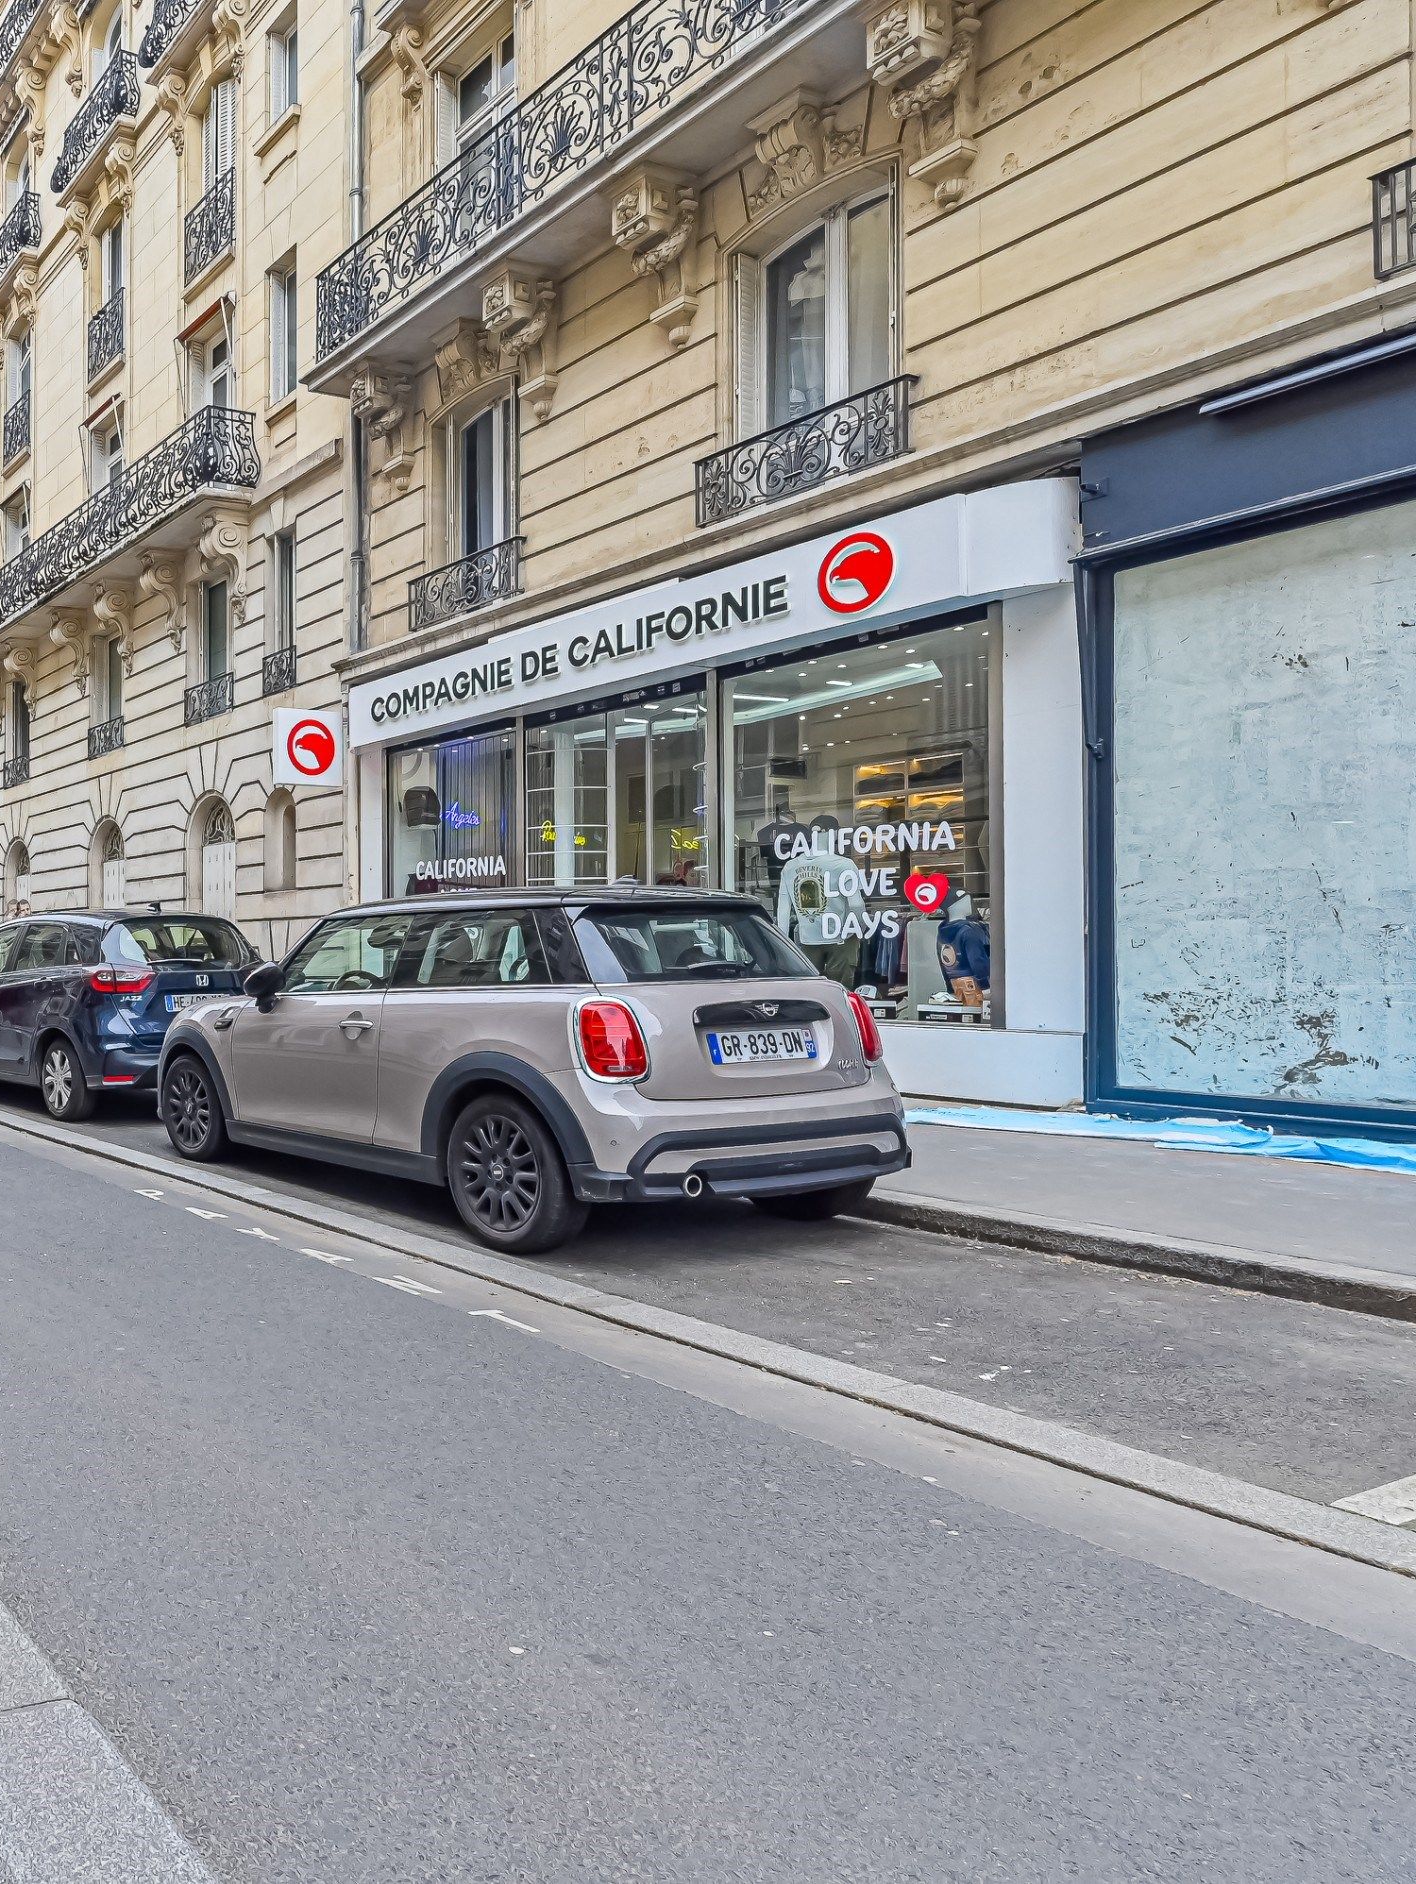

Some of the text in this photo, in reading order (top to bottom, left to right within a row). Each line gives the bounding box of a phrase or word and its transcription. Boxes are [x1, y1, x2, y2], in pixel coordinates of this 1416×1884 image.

[371, 574, 789, 723] COMPAGNIE DE CALIFORNIE
[774, 820, 956, 860] CALIFORNIA
[416, 855, 506, 880] CALIFORNIA
[824, 867, 897, 897] LOVE
[822, 910, 900, 939] DAYS
[721, 1031, 804, 1057] GR-839-DN
